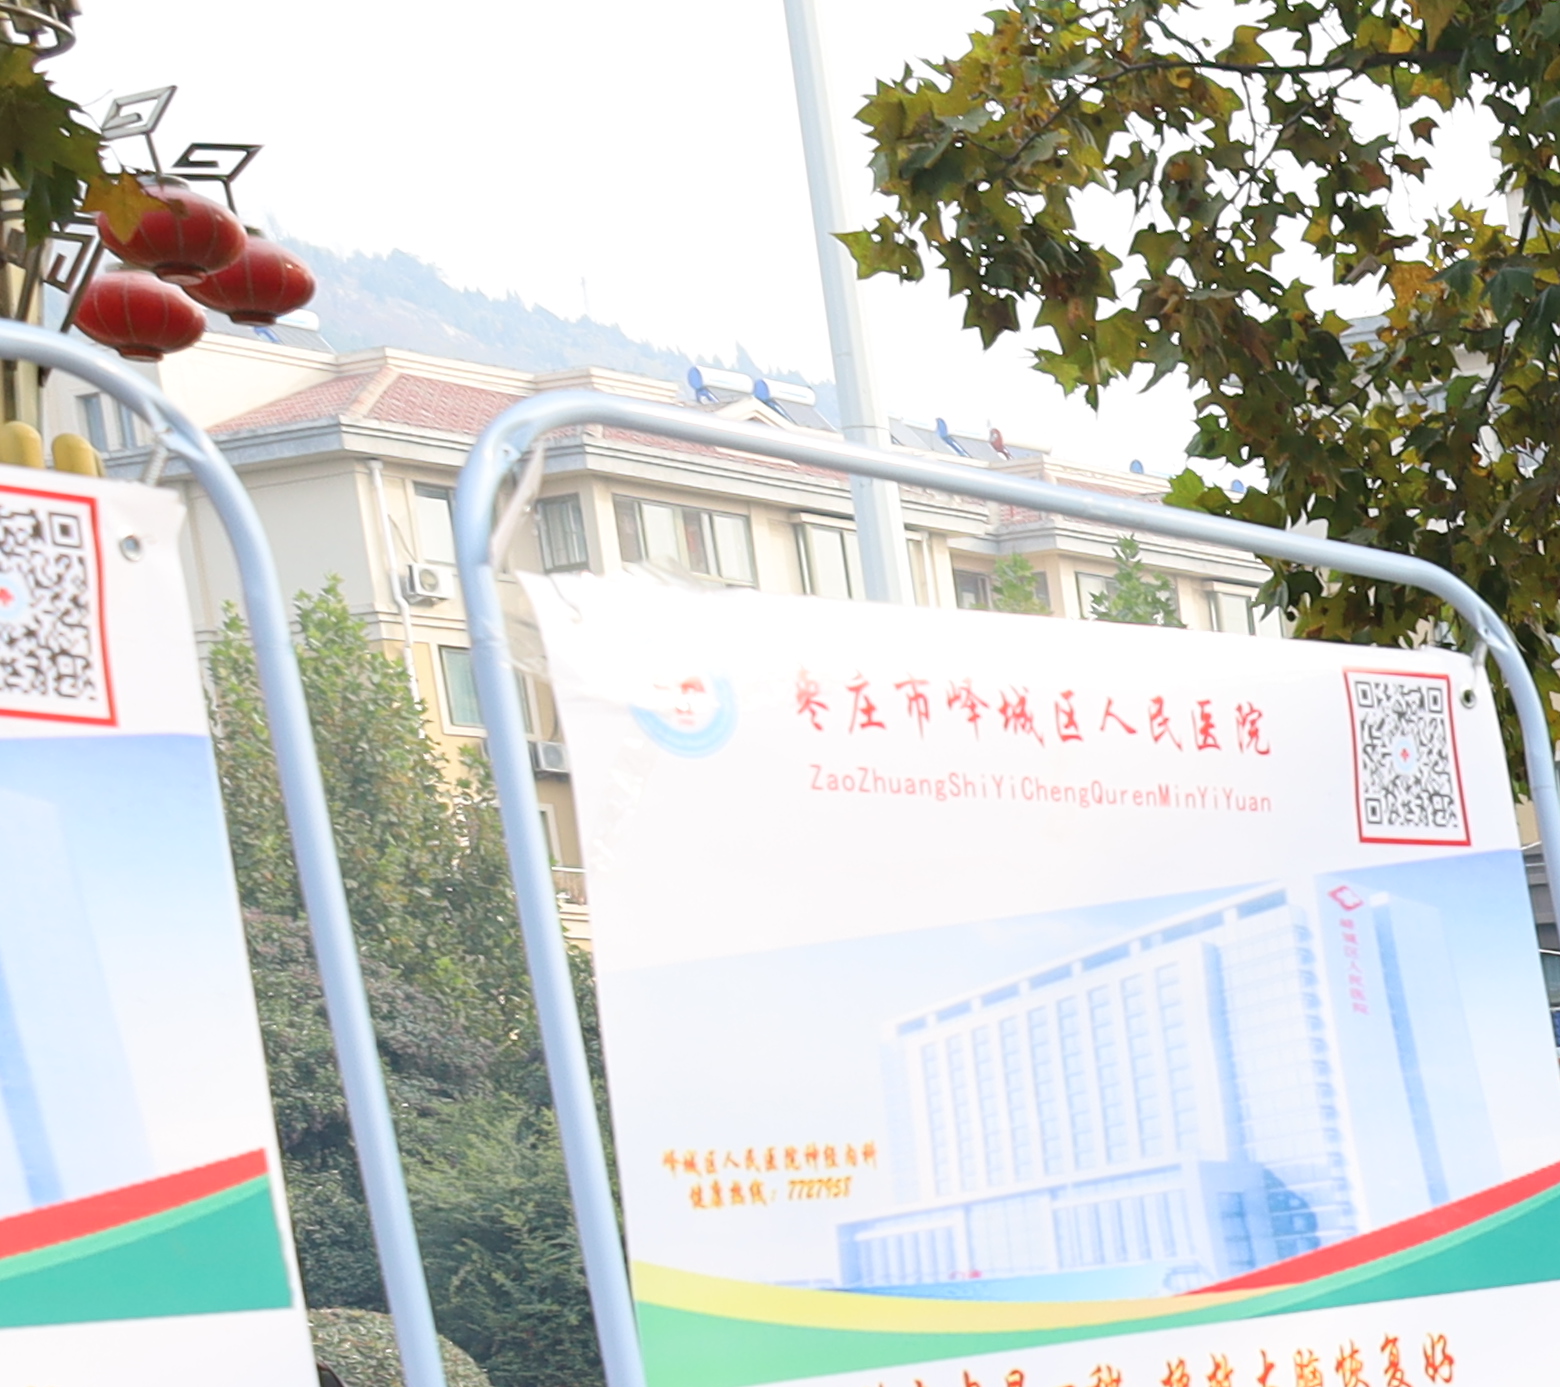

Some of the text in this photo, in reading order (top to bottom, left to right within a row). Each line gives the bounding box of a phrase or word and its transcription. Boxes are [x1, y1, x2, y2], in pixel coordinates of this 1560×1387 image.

[795, 670, 1272, 756] 枣庄市峄城区人民医院
